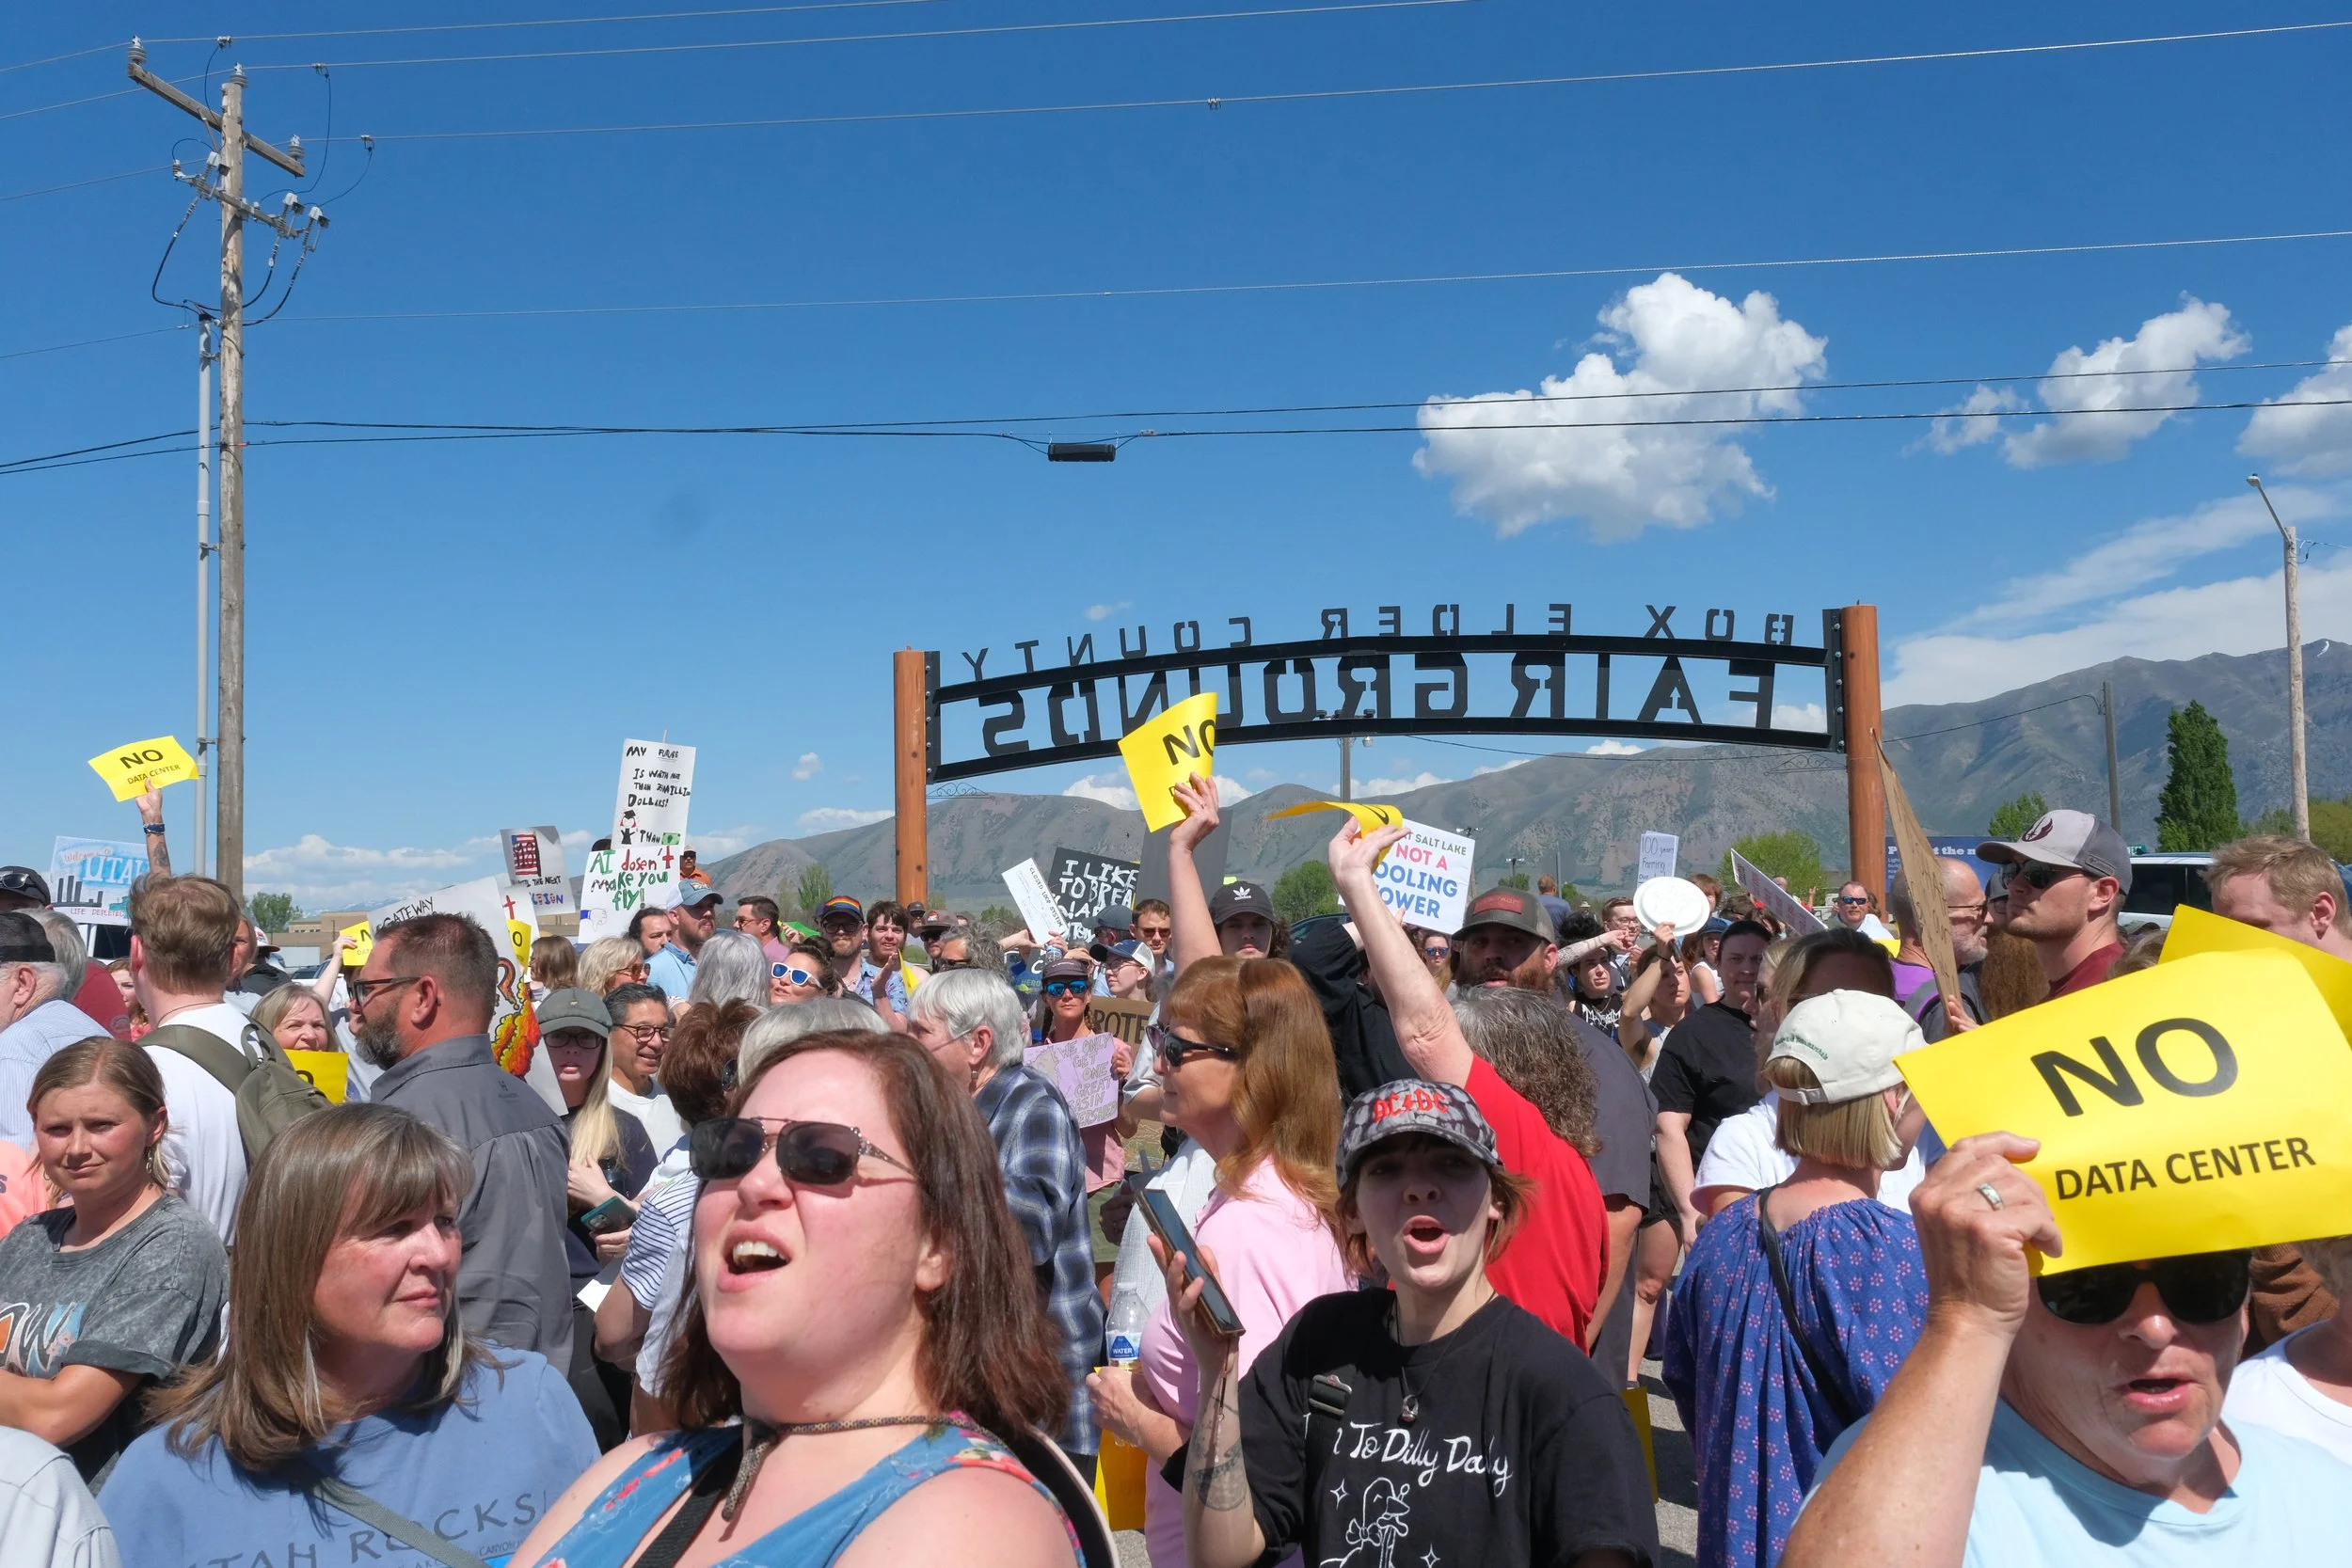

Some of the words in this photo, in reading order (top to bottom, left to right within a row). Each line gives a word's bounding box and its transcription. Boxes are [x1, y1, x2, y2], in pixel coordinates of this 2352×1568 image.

[119, 750, 164, 768] NO
[626, 746, 646, 756] MY
[127, 773, 149, 784] DATA
[149, 764, 182, 777] CENTER
[632, 768, 644, 779] IS
[1415, 833, 1440, 848] SALT
[1441, 840, 1468, 856] LAKE
[1642, 837, 1658, 854] 100
[1942, 847, 1964, 855] the
[590, 849, 616, 875] AI
[1395, 843, 1433, 865] NOT
[1436, 855, 1448, 871] A
[545, 875, 562, 885] NEXT
[638, 872, 669, 887] you
[1062, 860, 1079, 877] I
[1083, 863, 1139, 890] LIKE
[1374, 862, 1458, 898] OOLING
[612, 888, 645, 911] fly!
[1059, 877, 1087, 899] TO
[1089, 879, 1134, 908] BREA
[1376, 884, 1441, 919] OWER
[1093, 1009, 1151, 1044] ROTE
[1082, 1035, 1110, 1054] ONLY
[1073, 1052, 1097, 1069] GET
[1082, 1061, 1109, 1082] ONE
[2030, 1018, 2238, 1117] NO
[1074, 1075, 1111, 1099] GREAT
[1077, 1101, 1117, 1127] ERSHED
[2055, 1159, 2157, 1200] DATA
[2166, 1137, 2316, 1185] CENTER
[1112, 1346, 1133, 1354] WATER
[1349, 1421, 1383, 1459] To
[1381, 1426, 1441, 1487] Dilly
[188, 1541, 316, 1568] TAH
